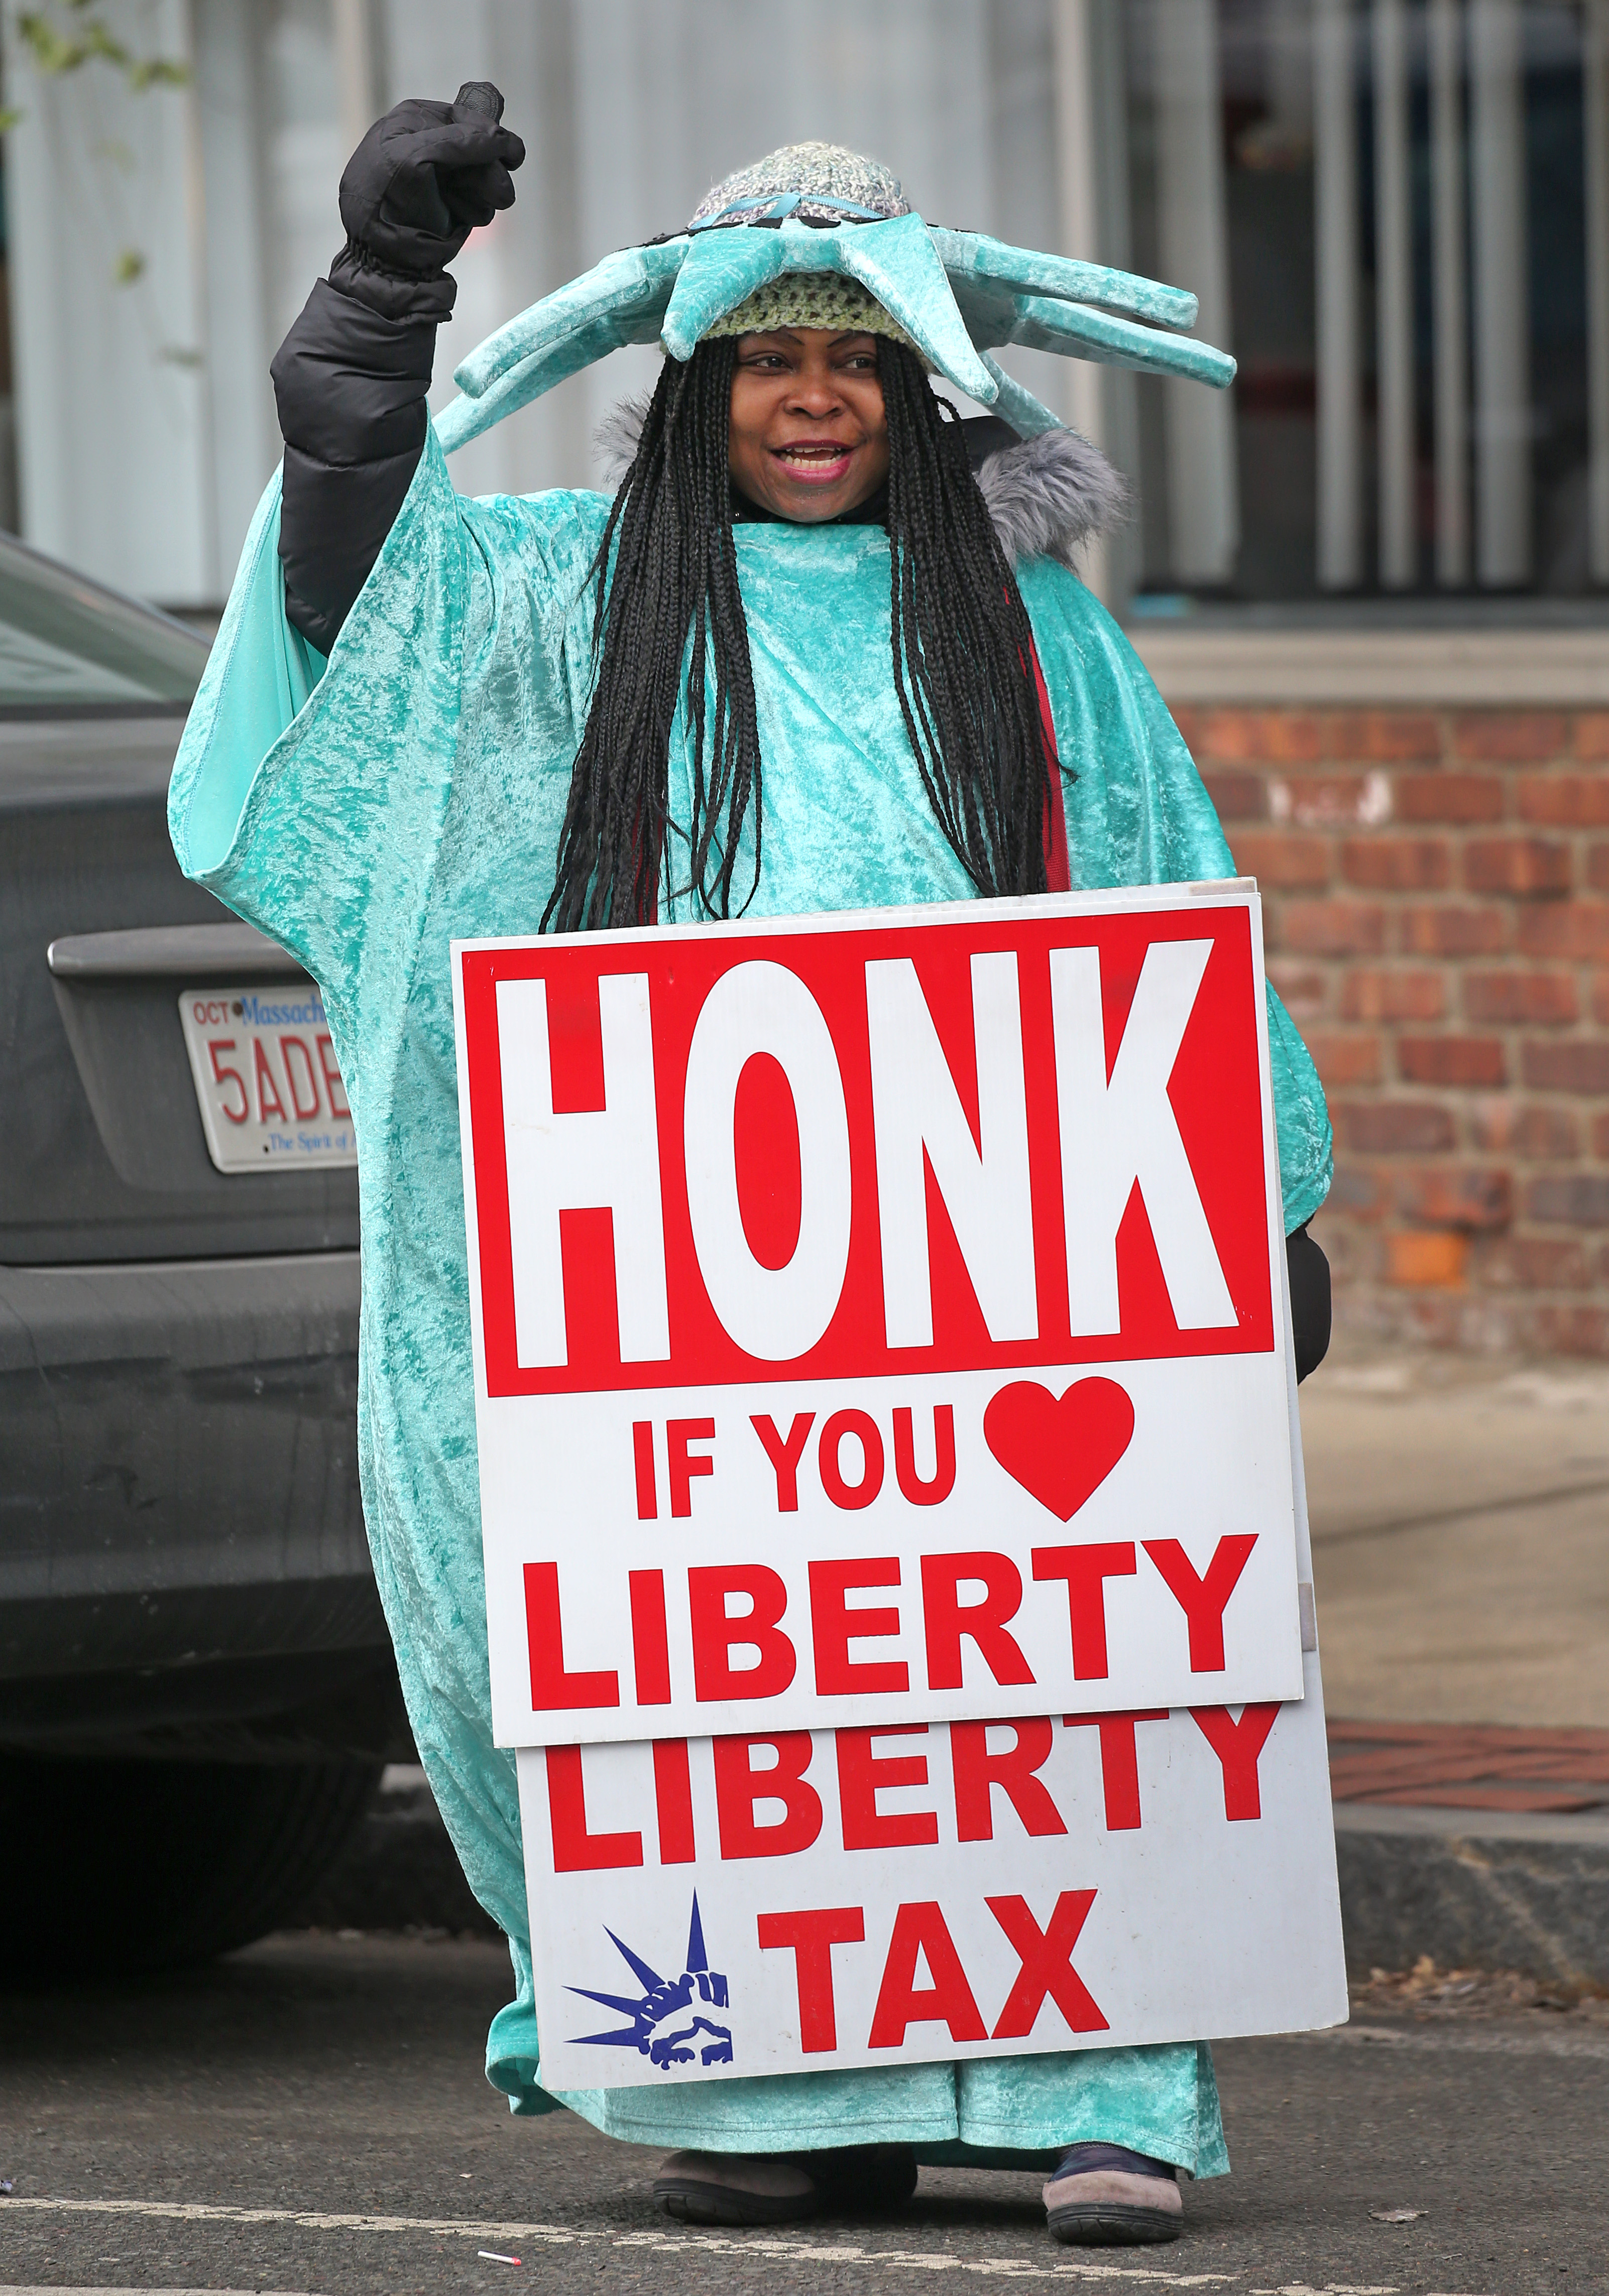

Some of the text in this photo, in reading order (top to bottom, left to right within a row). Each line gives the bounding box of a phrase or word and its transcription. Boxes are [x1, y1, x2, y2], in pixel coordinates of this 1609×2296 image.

[193, 1001, 228, 1025] OCT
[208, 1034, 352, 1124] 5ADE
[268, 1132, 293, 1151] The
[297, 1131, 331, 1153] Spirit
[335, 1131, 347, 1151] of
[495, 938, 1239, 1369] HONK
[633, 1405, 956, 1519] IF YOU
[523, 1535, 1258, 1711] LIBERTY
[546, 1703, 1278, 1872] LIBERTY
[757, 1890, 1109, 2052] TAX
